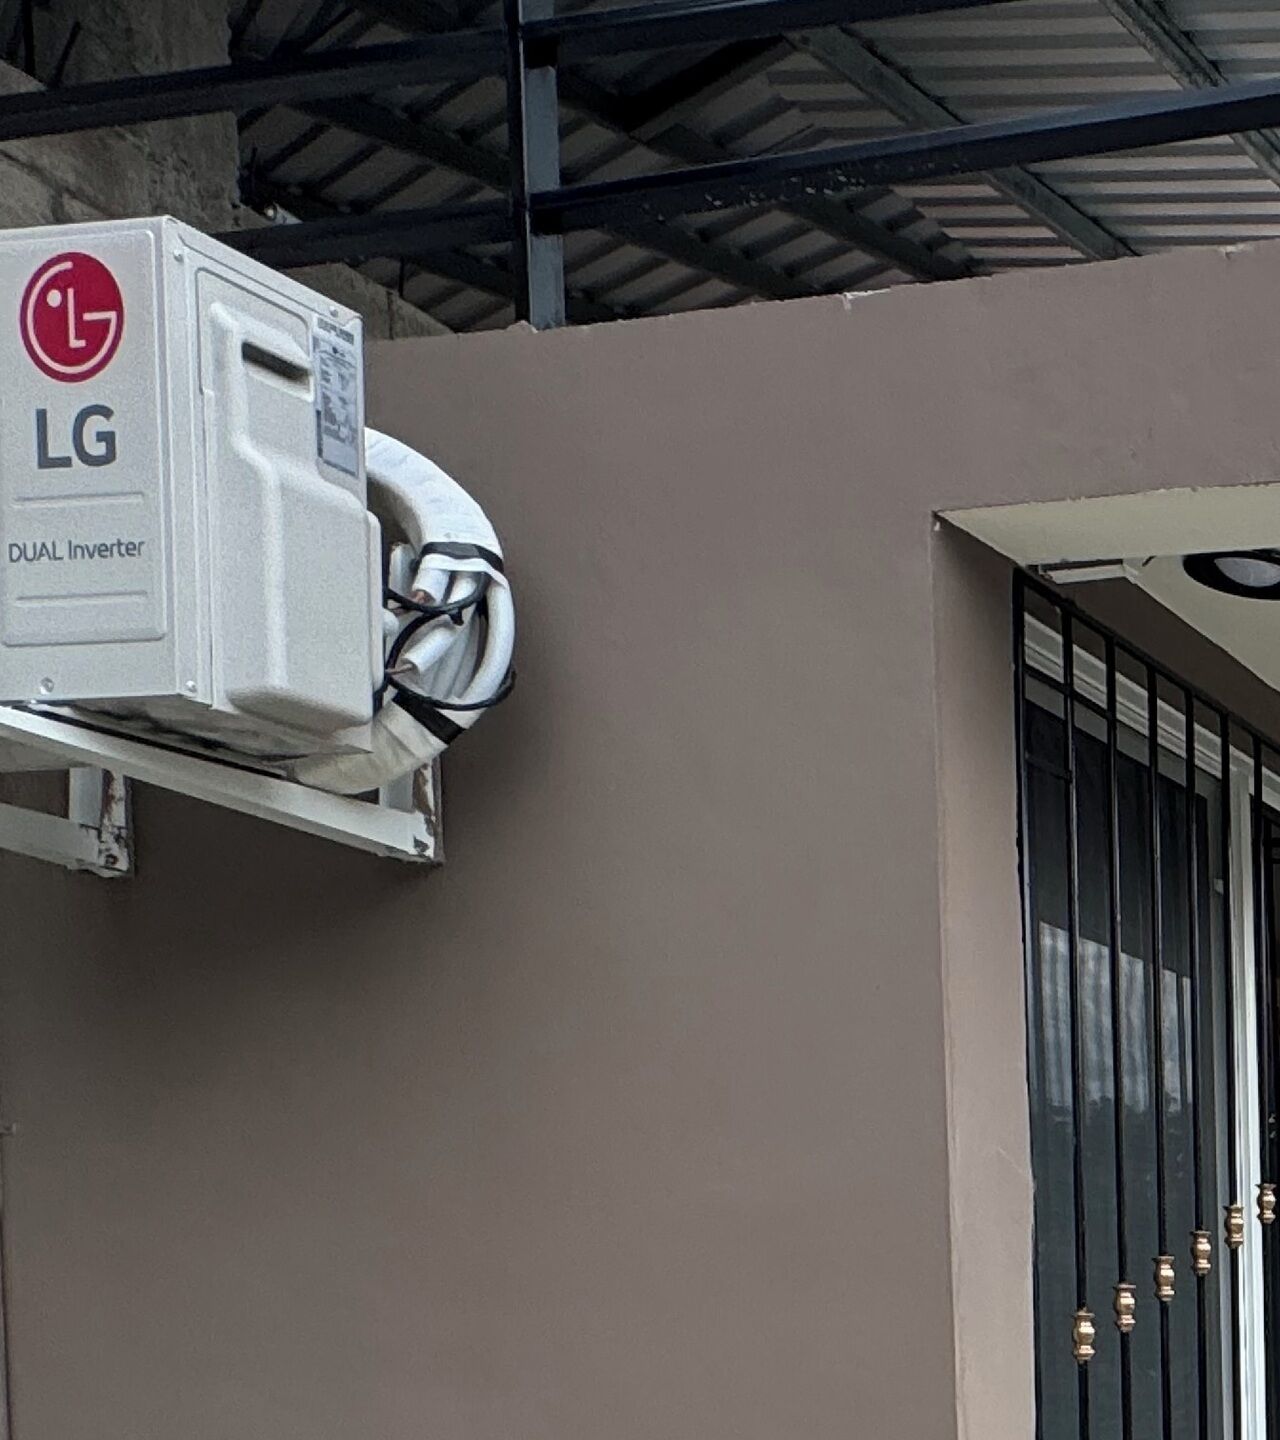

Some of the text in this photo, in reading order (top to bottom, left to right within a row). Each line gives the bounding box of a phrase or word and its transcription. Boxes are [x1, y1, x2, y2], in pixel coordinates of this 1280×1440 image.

[27, 261, 118, 375] LG
[36, 404, 117, 469] LG
[8, 538, 145, 563] DUAL Inverter
